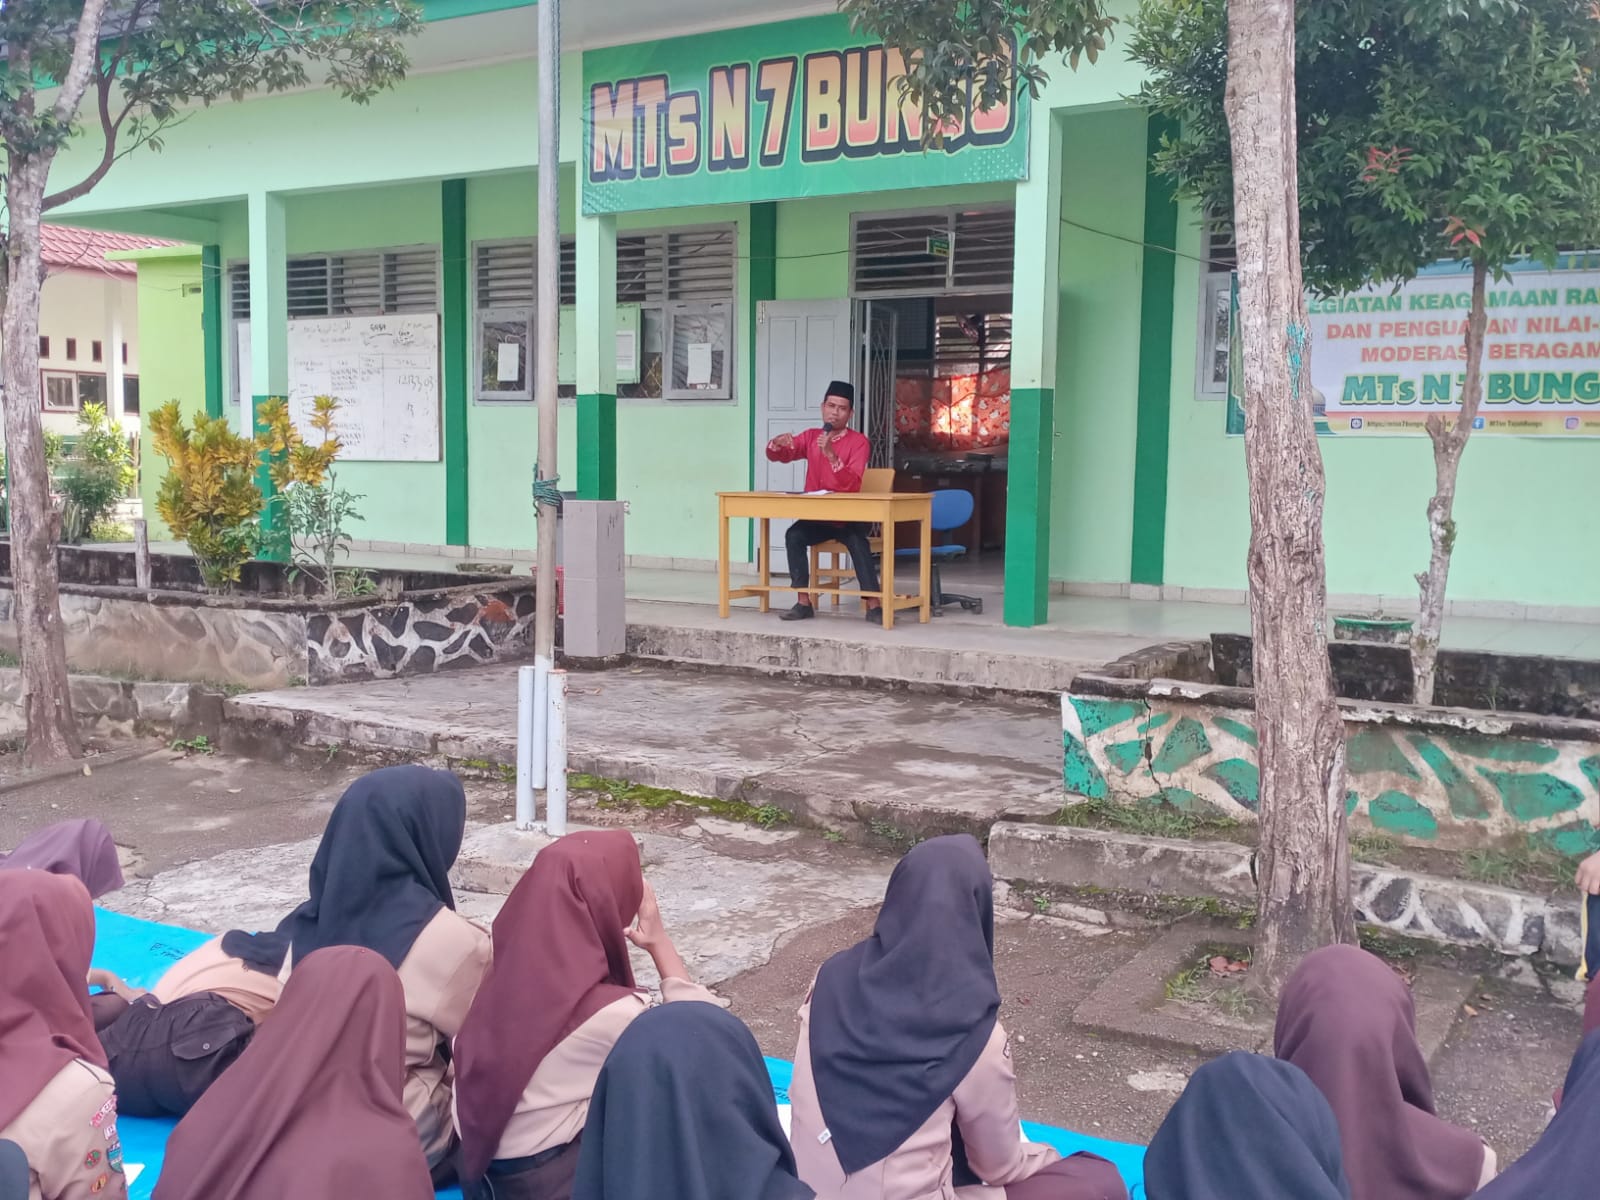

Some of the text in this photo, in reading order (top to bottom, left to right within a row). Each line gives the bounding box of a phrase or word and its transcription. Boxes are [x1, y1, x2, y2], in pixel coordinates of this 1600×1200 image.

[590, 74, 701, 182] MTs
[708, 62, 750, 172] N
[756, 56, 798, 167] 7
[1308, 295, 1402, 314] EGIATAN
[1409, 288, 1558, 311] KEAGMAAN
[1327, 323, 1372, 340] DAN
[1379, 317, 1519, 338] PENGUAAN
[1361, 345, 1469, 363] MODERAS
[1341, 374, 1417, 404] MTs
[1420, 372, 1452, 404] N
